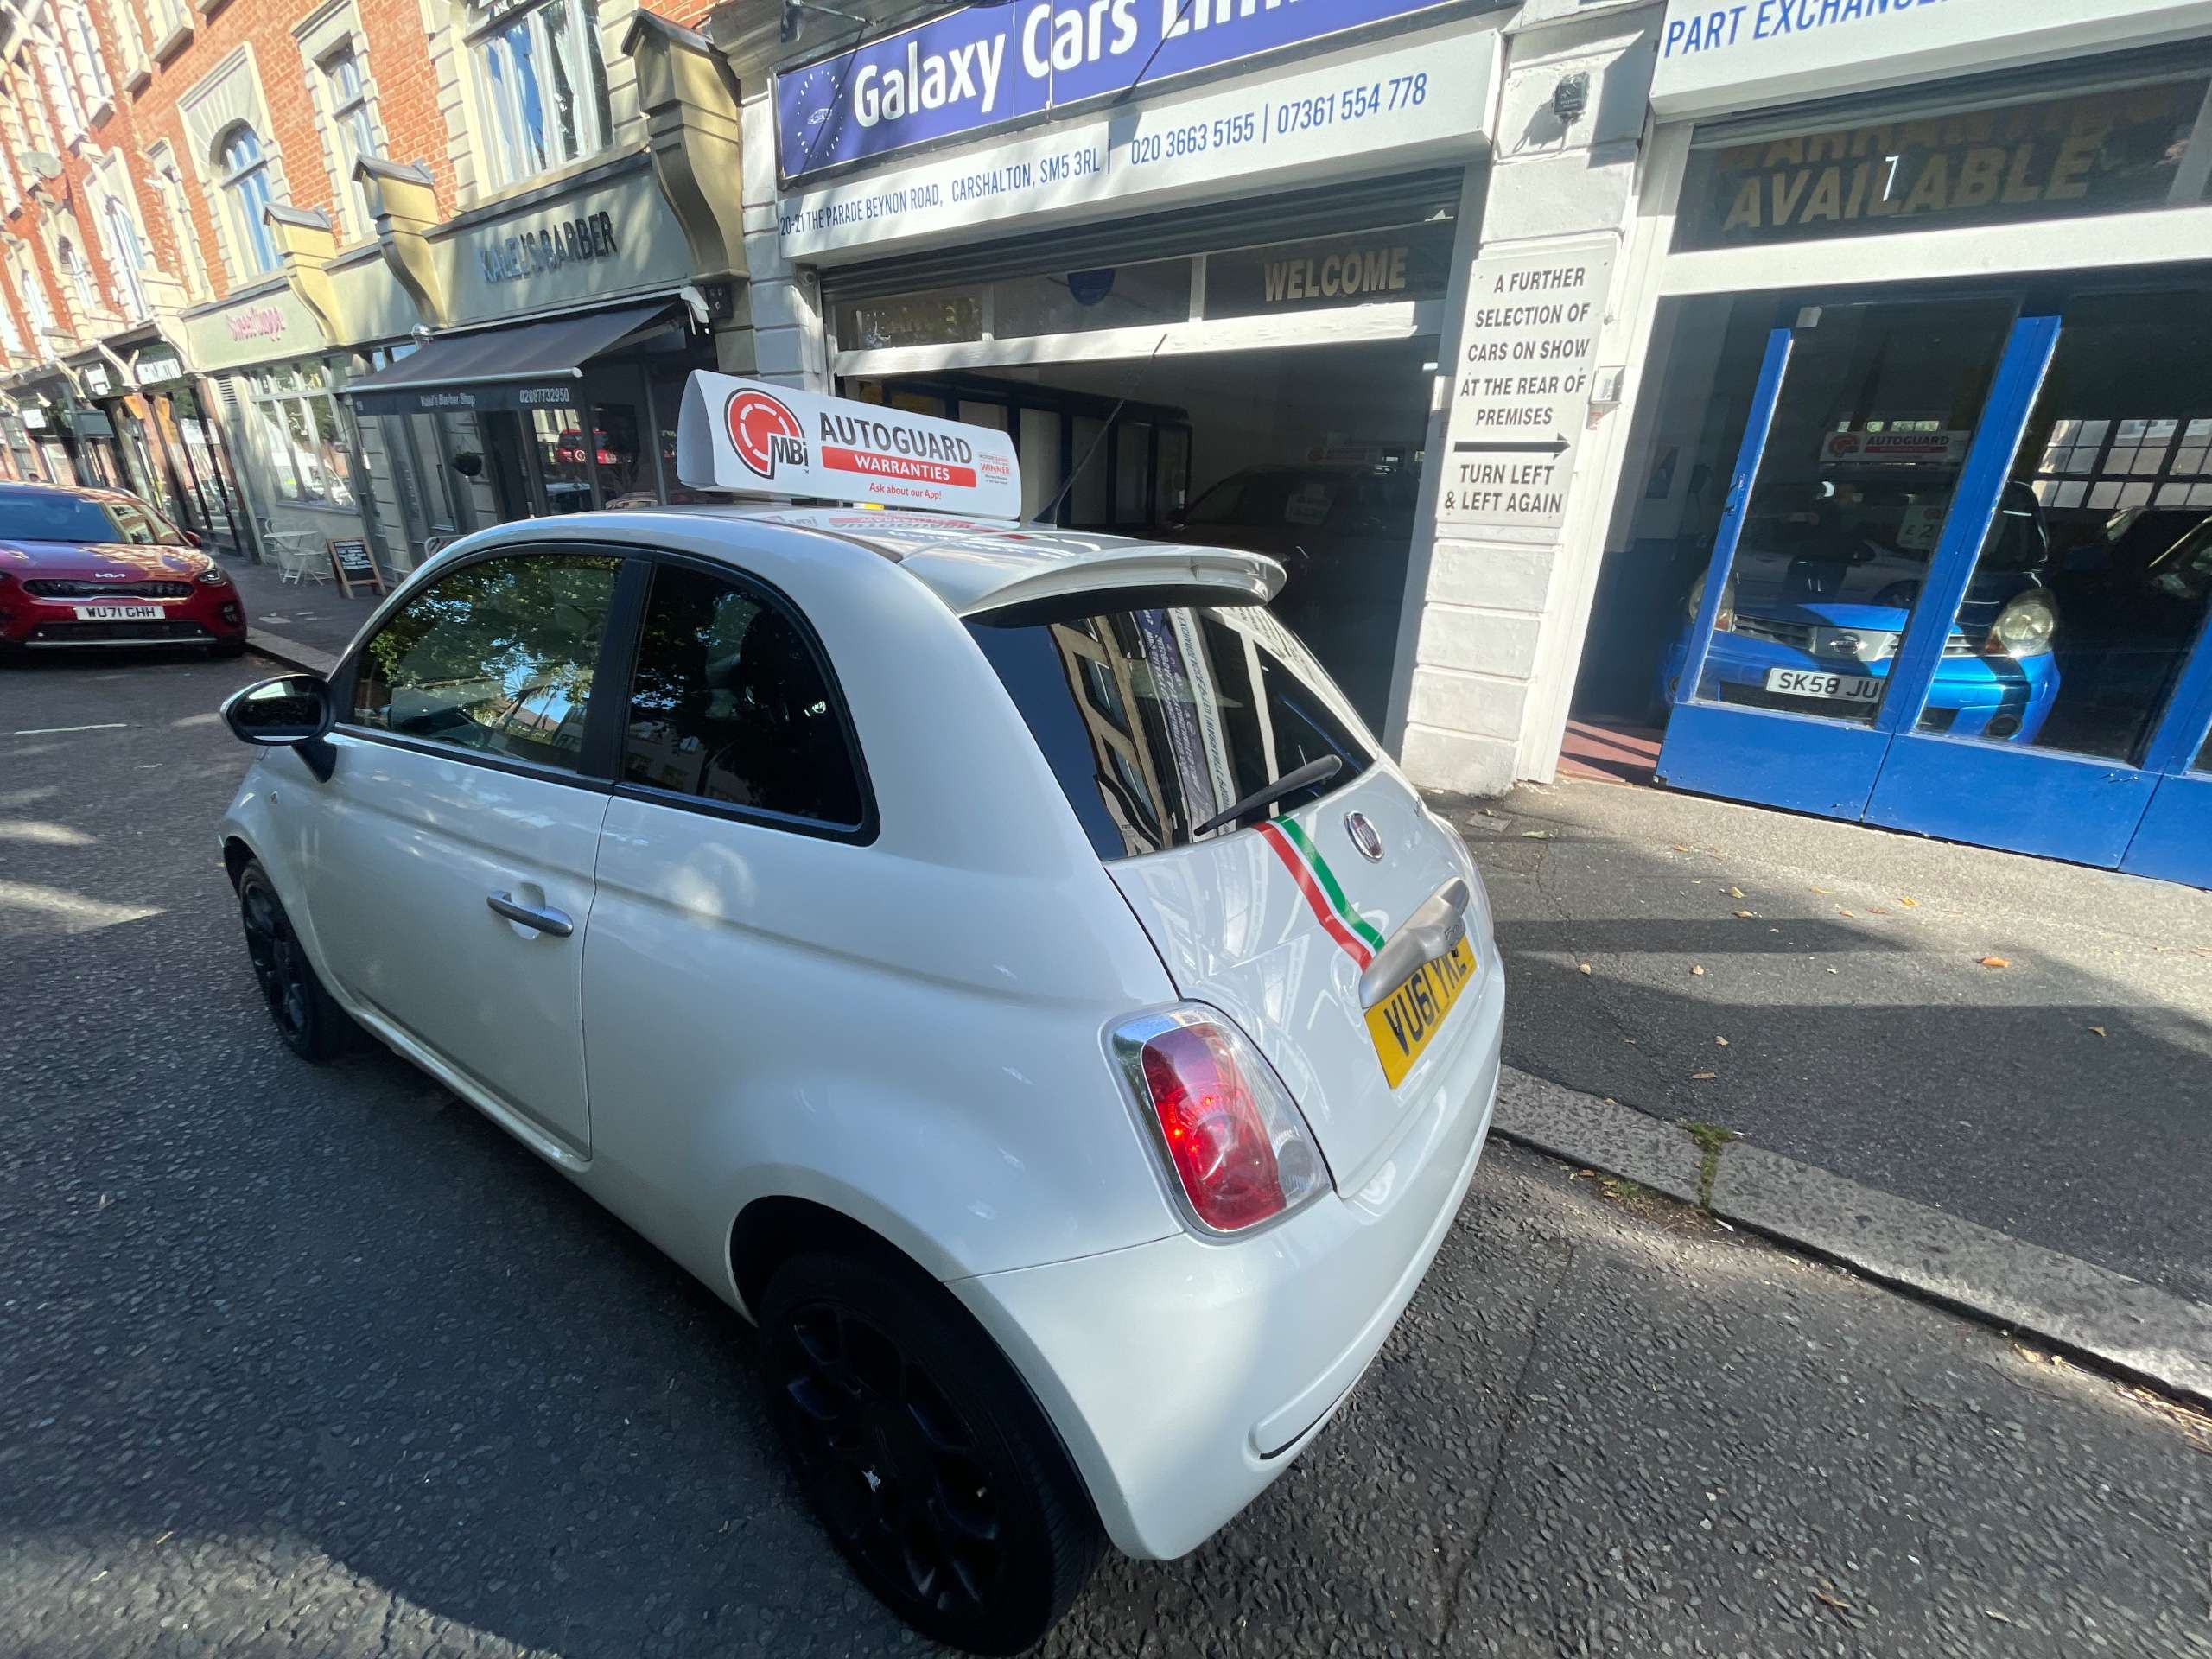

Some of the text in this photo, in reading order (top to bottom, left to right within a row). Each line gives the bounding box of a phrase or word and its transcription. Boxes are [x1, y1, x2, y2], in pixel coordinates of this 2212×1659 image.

[1663, 5, 1747, 58] PART
[854, 33, 1007, 127] Galaxy
[1022, 0, 1139, 79] Cars
[1277, 73, 1428, 135] 07361 554 778
[1130, 112, 1255, 166] 020 3663 5155
[805, 209, 824, 231] THE
[826, 202, 864, 227] PARADE
[865, 194, 907, 219] BEYNON
[910, 184, 944, 210] ROAD,
[951, 164, 1036, 203] CARSHALTON,
[1039, 154, 1070, 184] SM5
[1073, 147, 1101, 175] 3RL
[1723, 137, 2100, 232] AVAILABLE
[539, 211, 618, 270] BARBER
[1263, 246, 1410, 302] WELCOME
[1494, 267, 1586, 294] A FURTHER
[1475, 302, 1591, 328] SELECTION OF
[1468, 338, 1591, 362] CARS ON SHOW
[1460, 378, 1480, 397] AT
[1484, 378, 1513, 396] THE
[1517, 376, 1559, 395] REAR
[1564, 374, 1587, 393] OF
[1476, 407, 1554, 425] PREMISES
[820, 412, 973, 464] AUTOGUARD
[1866, 435, 1950, 446] AUTOGUARD
[855, 454, 950, 481] WARRANTIES
[981, 462, 1010, 474] WINNER
[1459, 464, 1555, 485] TURN LEFT
[869, 482, 942, 500] Ask about our App!
[1445, 491, 1564, 513] & LEFT AGAIN
[86, 607, 156, 618] WU71 GHH
[1778, 672, 1841, 695] SK58
[1383, 968, 1440, 1057] VU61
